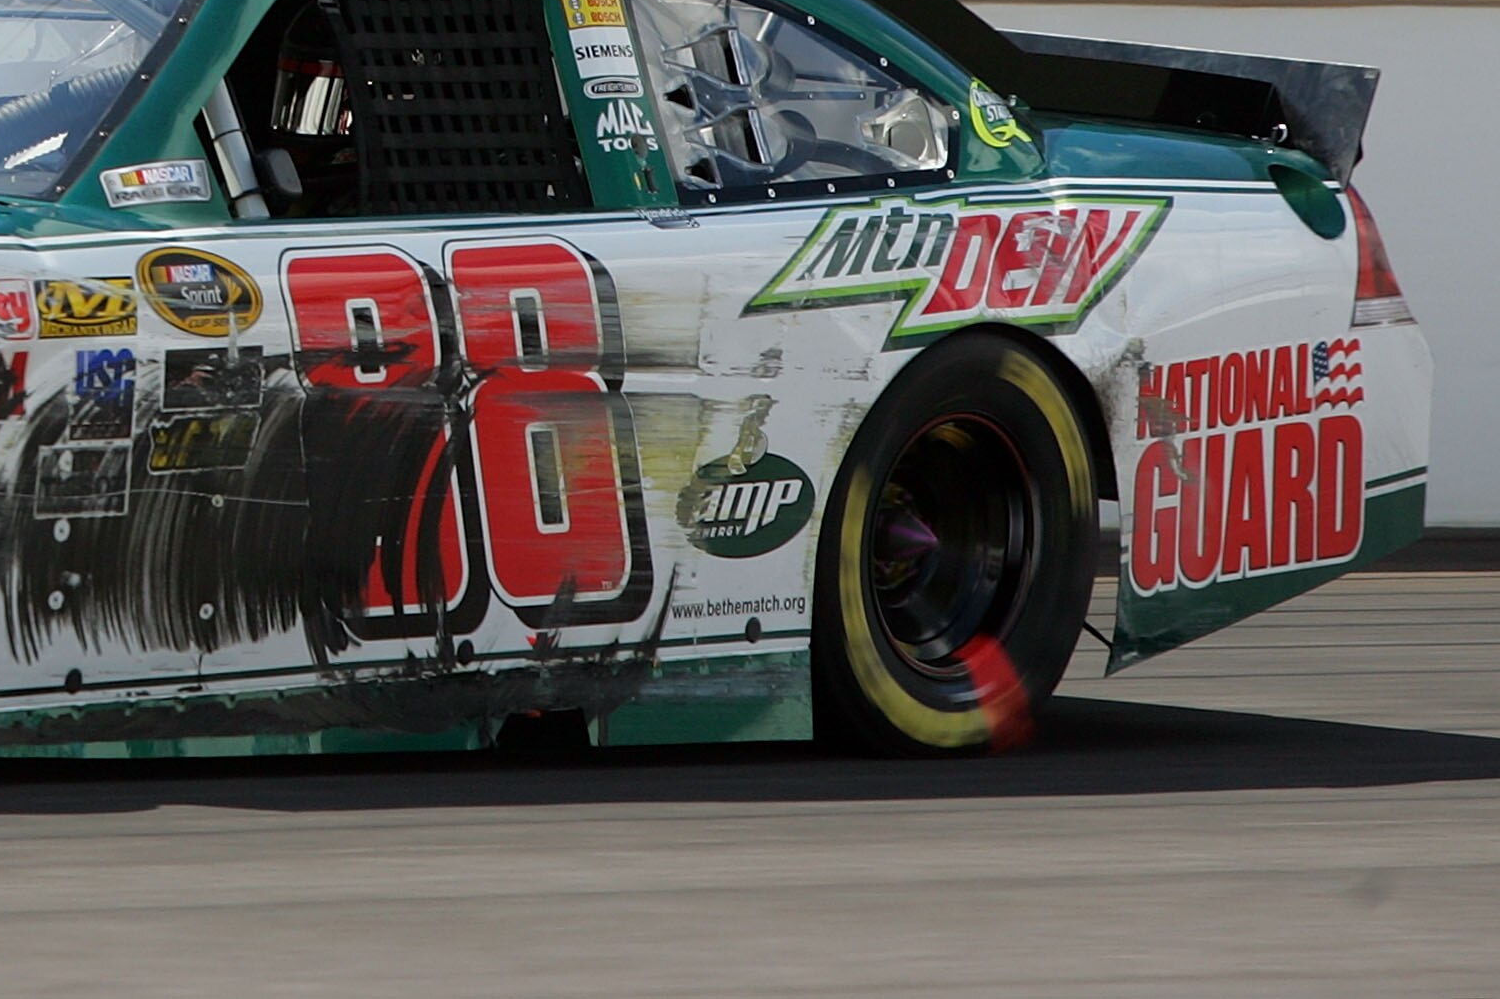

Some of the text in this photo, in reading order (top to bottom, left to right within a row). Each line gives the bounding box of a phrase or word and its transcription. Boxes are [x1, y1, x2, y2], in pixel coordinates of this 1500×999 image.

[590, 12, 622, 22] BOSCH
[575, 45, 633, 60] SIEMENS
[596, 98, 655, 137] MAC
[598, 137, 659, 152] TOS
[141, 165, 191, 184] NASCAR
[115, 185, 200, 201] RACE CAR
[170, 264, 214, 282] NASCAR
[181, 285, 223, 306] Sprint
[1137, 343, 1314, 440] NATIONAL
[1131, 415, 1362, 591] GUARD
[692, 526, 743, 538] NERGY
[671, 596, 806, 619] www.bethematch.org
